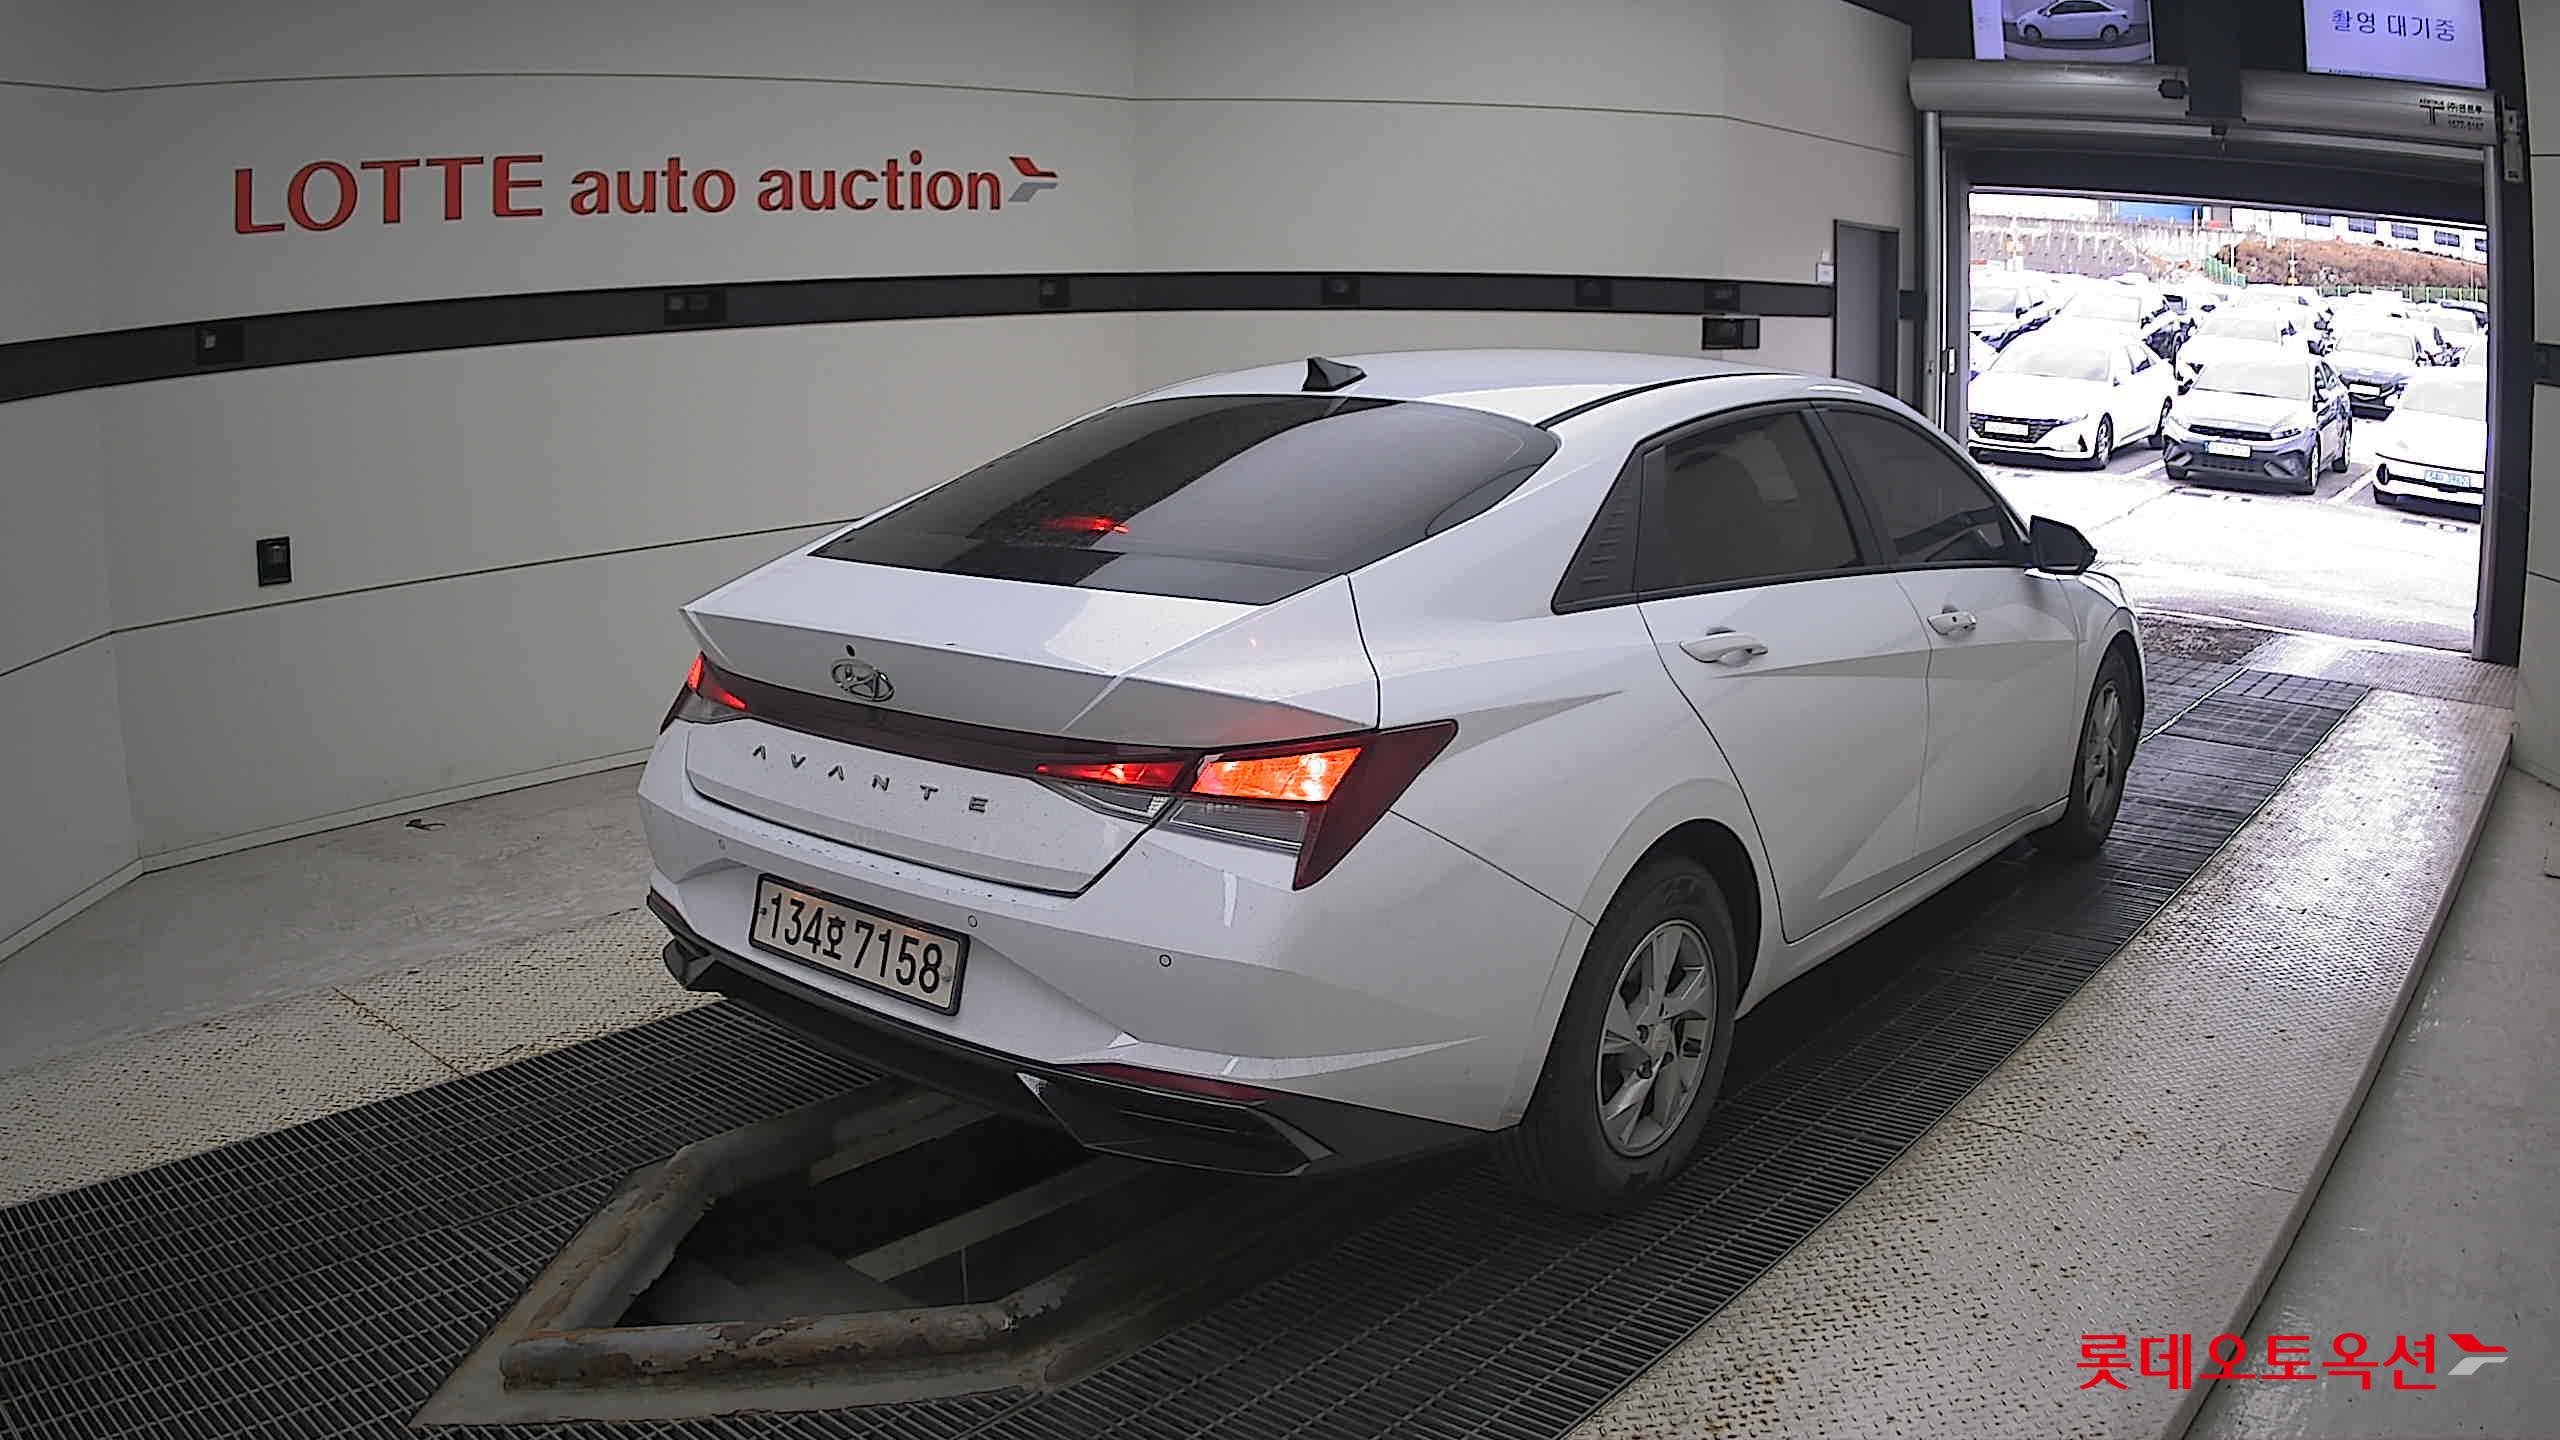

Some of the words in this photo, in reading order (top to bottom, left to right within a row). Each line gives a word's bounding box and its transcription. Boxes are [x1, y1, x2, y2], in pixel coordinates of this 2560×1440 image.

[2331, 9, 2376, 34] 촬영
[2387, 15, 2455, 42] 대기중
[234, 155, 544, 235] LOTTE
[570, 156, 736, 216] auto
[757, 150, 1001, 211] auction
[752, 744, 989, 813] AVANTE
[770, 892, 846, 961] 134호
[853, 919, 943, 994] 7158
